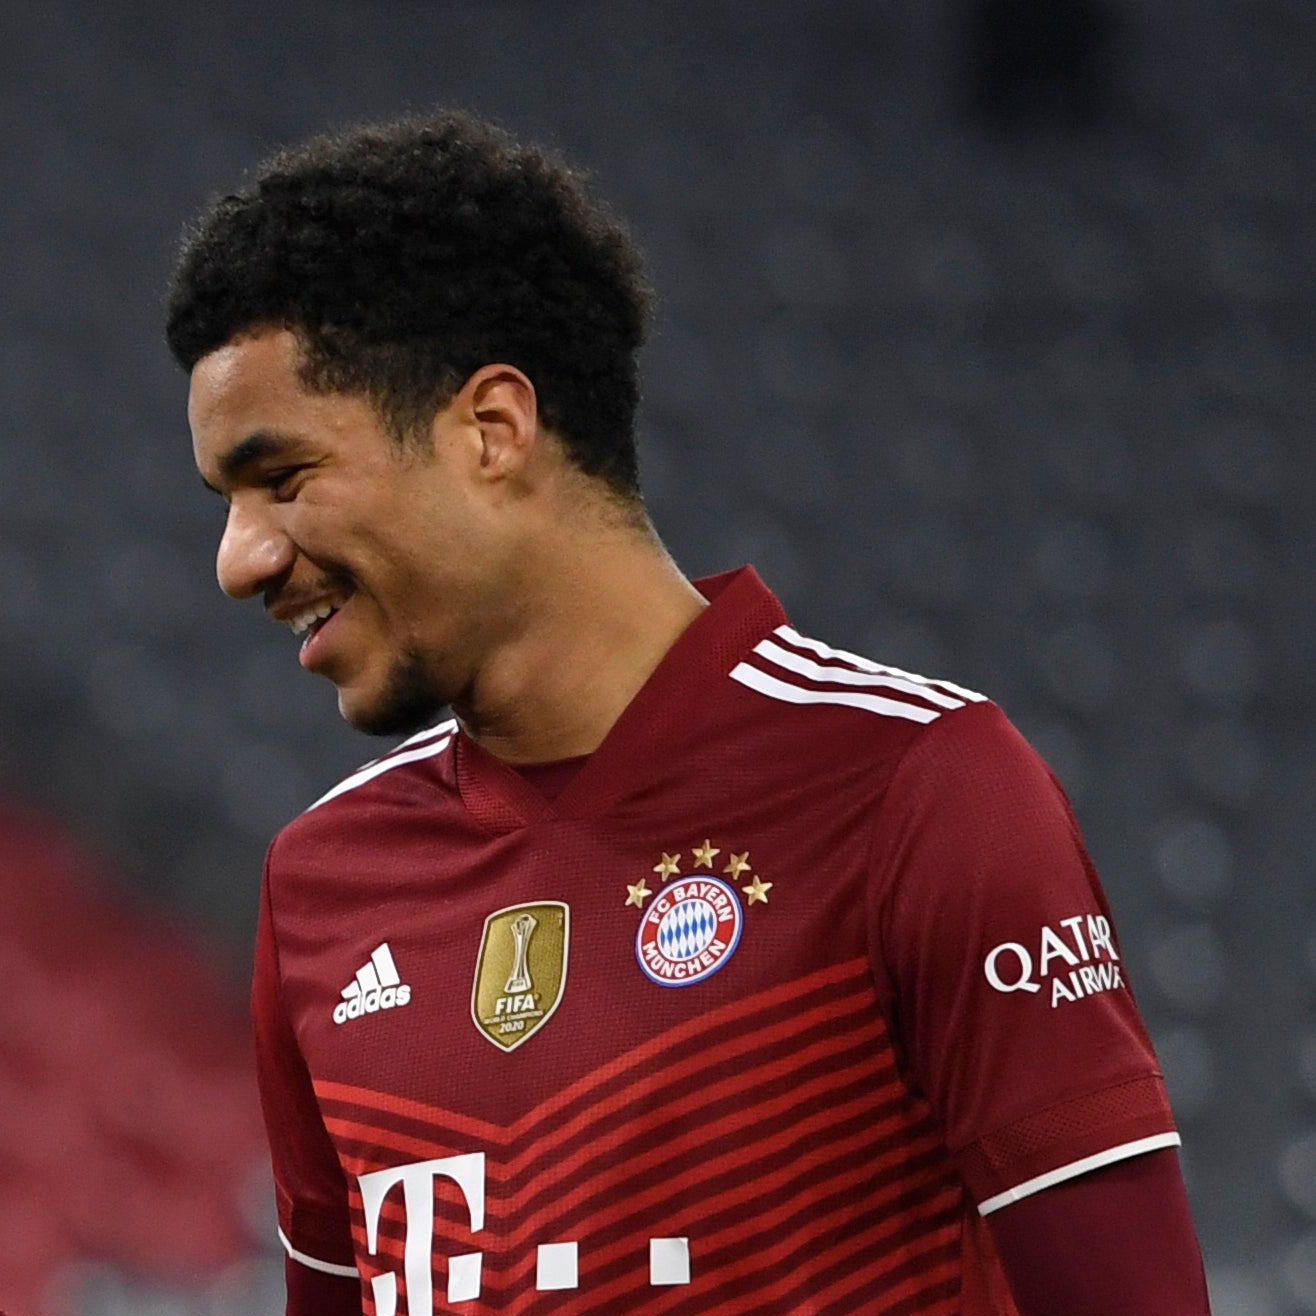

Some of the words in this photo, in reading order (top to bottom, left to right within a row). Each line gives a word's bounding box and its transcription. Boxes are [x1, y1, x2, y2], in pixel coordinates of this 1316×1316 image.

[648, 898, 671, 924] FC
[672, 883, 734, 923] BAYERN
[642, 940, 727, 978] MÜNCHEN
[984, 914, 1121, 993] QATAR
[332, 982, 412, 1025] adidas
[495, 994, 536, 1016] FIFA
[499, 1020, 525, 1033] 2020
